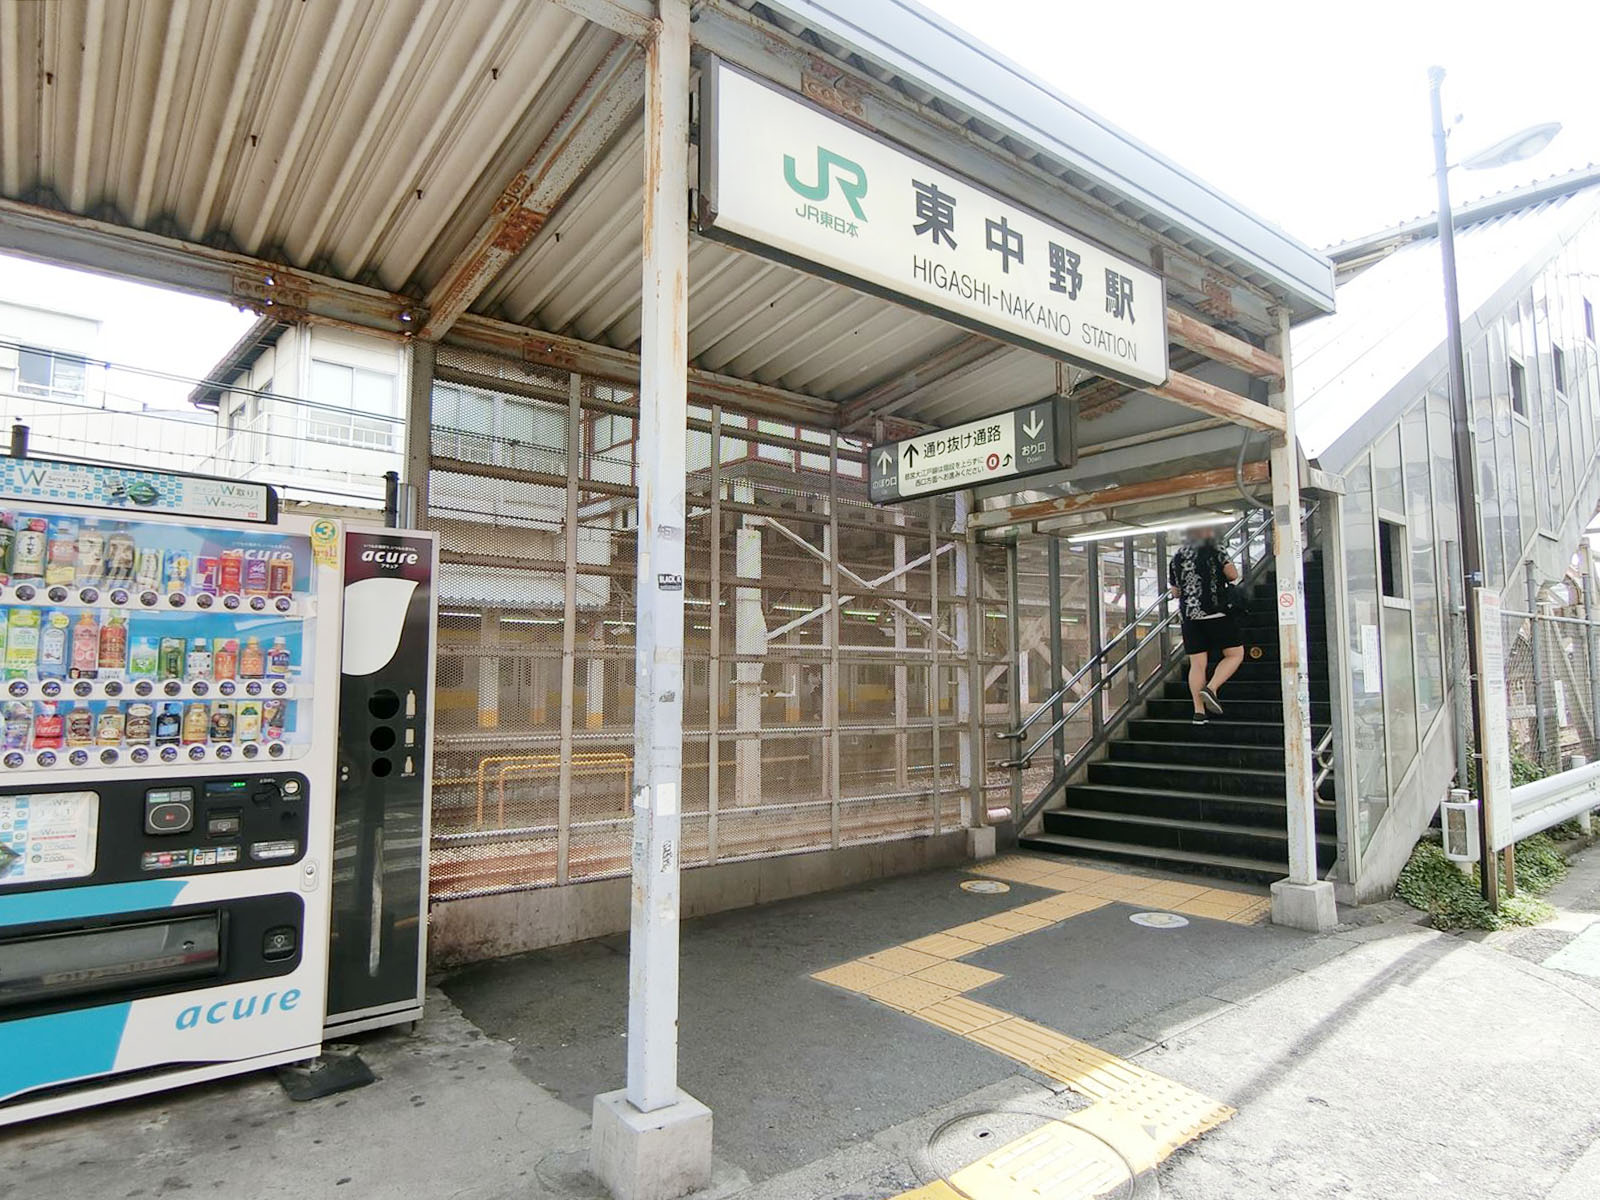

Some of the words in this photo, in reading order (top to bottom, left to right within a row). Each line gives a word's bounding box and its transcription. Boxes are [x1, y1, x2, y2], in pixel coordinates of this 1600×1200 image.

[783, 145, 868, 223] JR
[795, 203, 859, 238] JR東日本
[912, 178, 1136, 325] 東中野駅
[913, 255, 1071, 336] HIGASHI-NAKANO
[1081, 323, 1138, 363] STATION
[923, 424, 1002, 459] 通り抜け通路
[1021, 441, 1047, 456] おり口
[872, 476, 898, 489] のぼり口
[361, 550, 419, 565] acure
[175, 987, 301, 1031] acure
